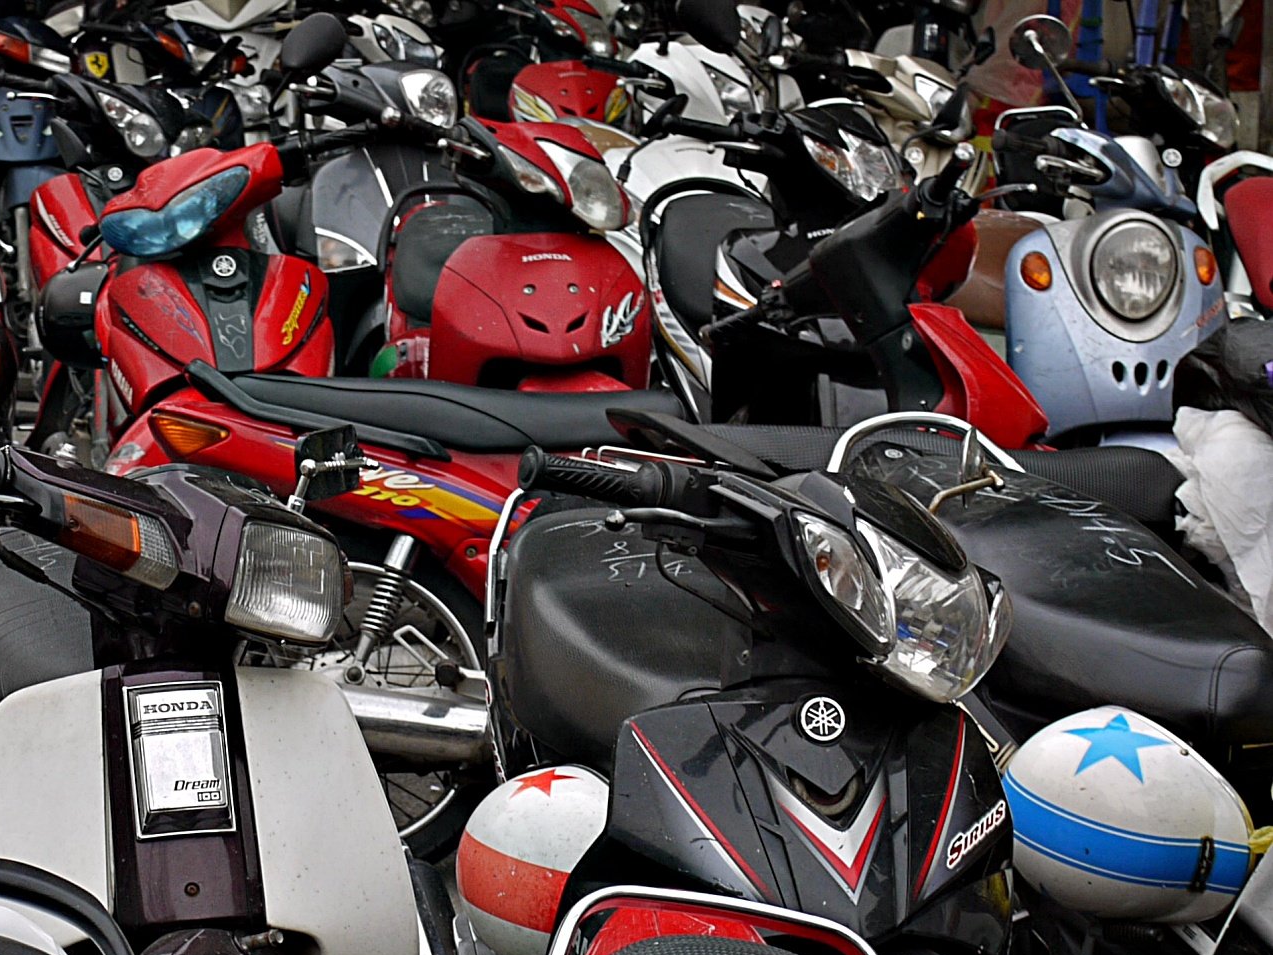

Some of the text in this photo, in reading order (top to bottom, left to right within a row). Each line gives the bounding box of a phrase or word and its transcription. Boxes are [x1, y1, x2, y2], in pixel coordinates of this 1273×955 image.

[522, 253, 572, 262] HONDA
[360, 466, 435, 489] ve
[353, 485, 421, 506] 110
[143, 701, 213, 714] HONDA
[174, 780, 221, 791] Dream
[198, 791, 221, 802] 100
[948, 801, 1005, 867] SIRIUS
